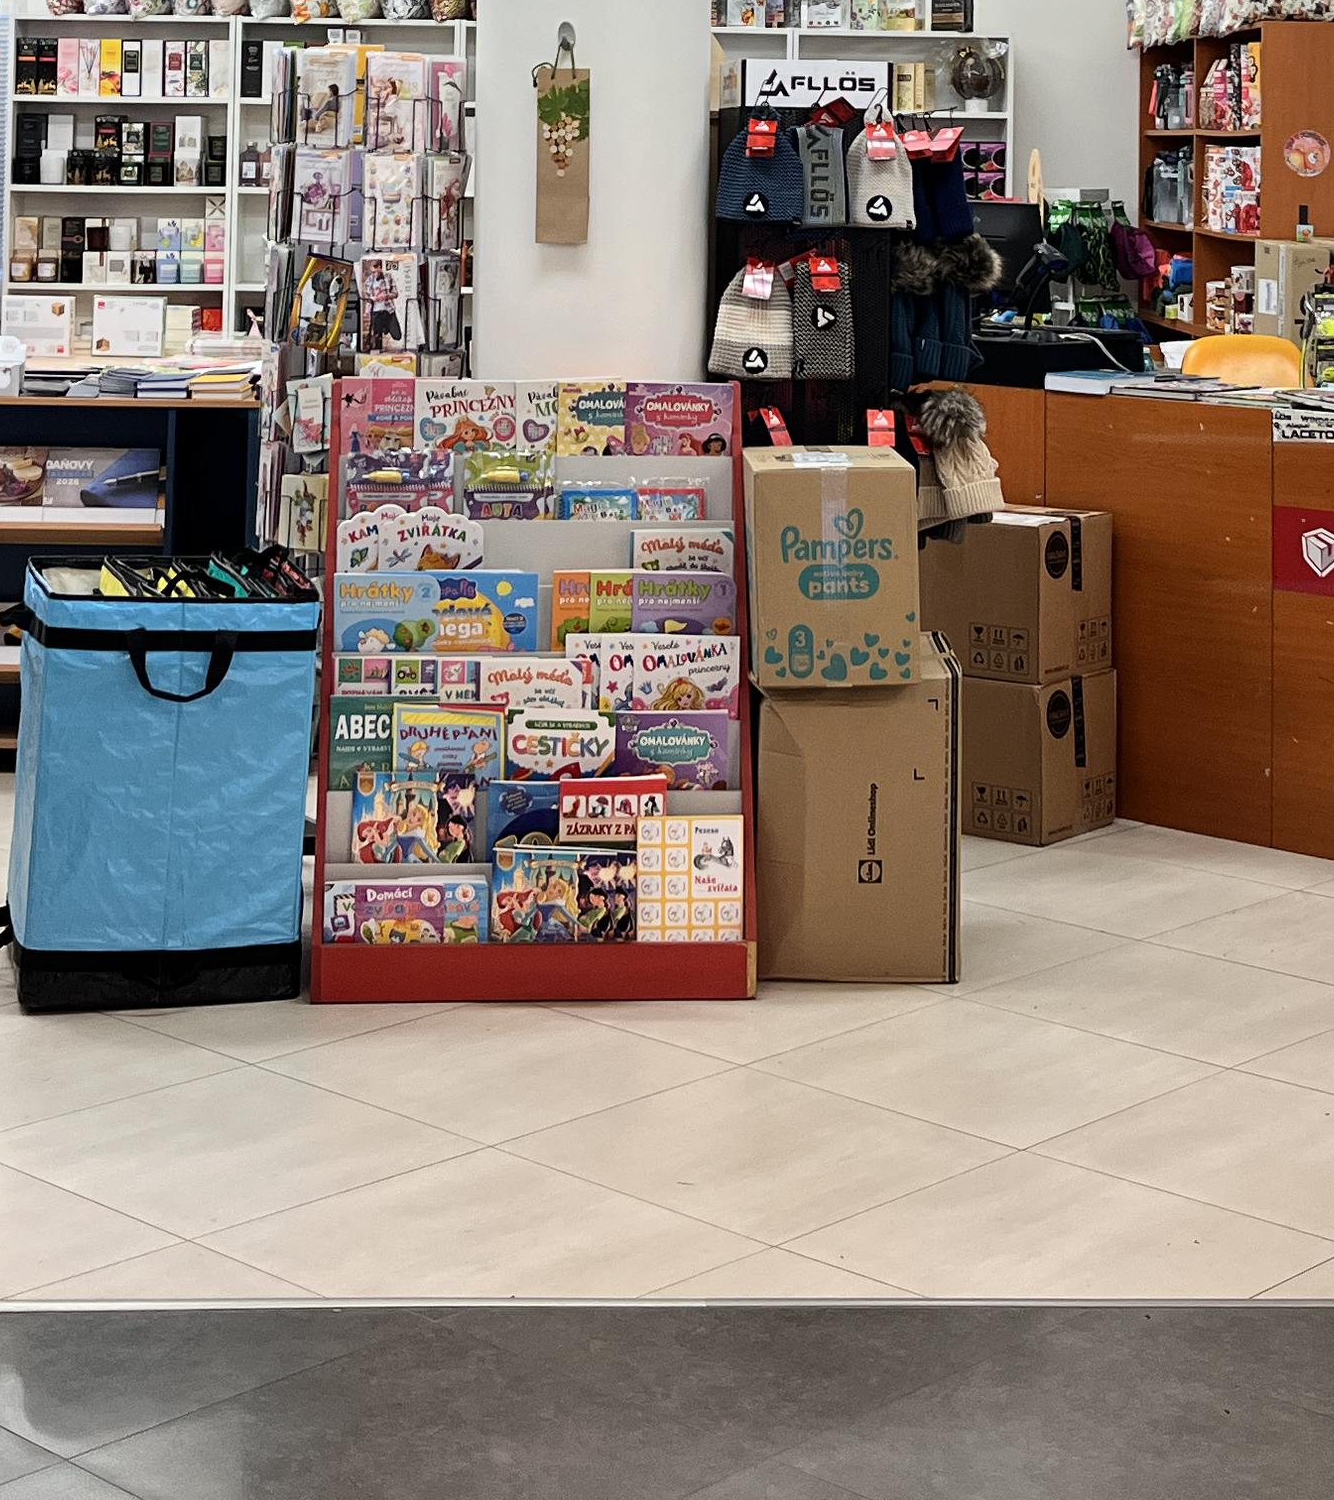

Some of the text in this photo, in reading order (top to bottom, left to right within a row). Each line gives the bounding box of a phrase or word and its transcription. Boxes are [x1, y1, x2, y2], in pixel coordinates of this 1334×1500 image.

[429, 394, 516, 419] PRINCEZNY
[646, 399, 711, 413] OMALOVÁNKY
[1281, 429, 1334, 440] LACETO
[480, 503, 523, 518] AUTA
[397, 522, 467, 543] ZVÍŘÁTKA
[641, 536, 686, 554] Malý
[779, 525, 892, 564] Pampers
[340, 581, 431, 602] Hrátky 2
[638, 579, 727, 603] Hrátky 1
[808, 579, 869, 598] pants
[559, 597, 573, 605] pro
[597, 598, 614, 606] pro
[638, 597, 700, 606] pro nejmenší
[795, 631, 806, 647] 3
[643, 642, 728, 672] OMALOVÁNKA
[487, 666, 533, 686] Malý
[688, 664, 731, 676] princezny
[335, 714, 391, 740] ABEC
[511, 731, 609, 758] CESTIČKY
[639, 733, 706, 747] OMALOVÁNKY
[566, 821, 613, 836] ZÁZRAKY
[615, 824, 623, 834] Z
[867, 838, 876, 855] Lidl
[695, 875, 717, 884] Naše
[366, 887, 412, 902] Domácí
[707, 884, 738, 893] zvířata
